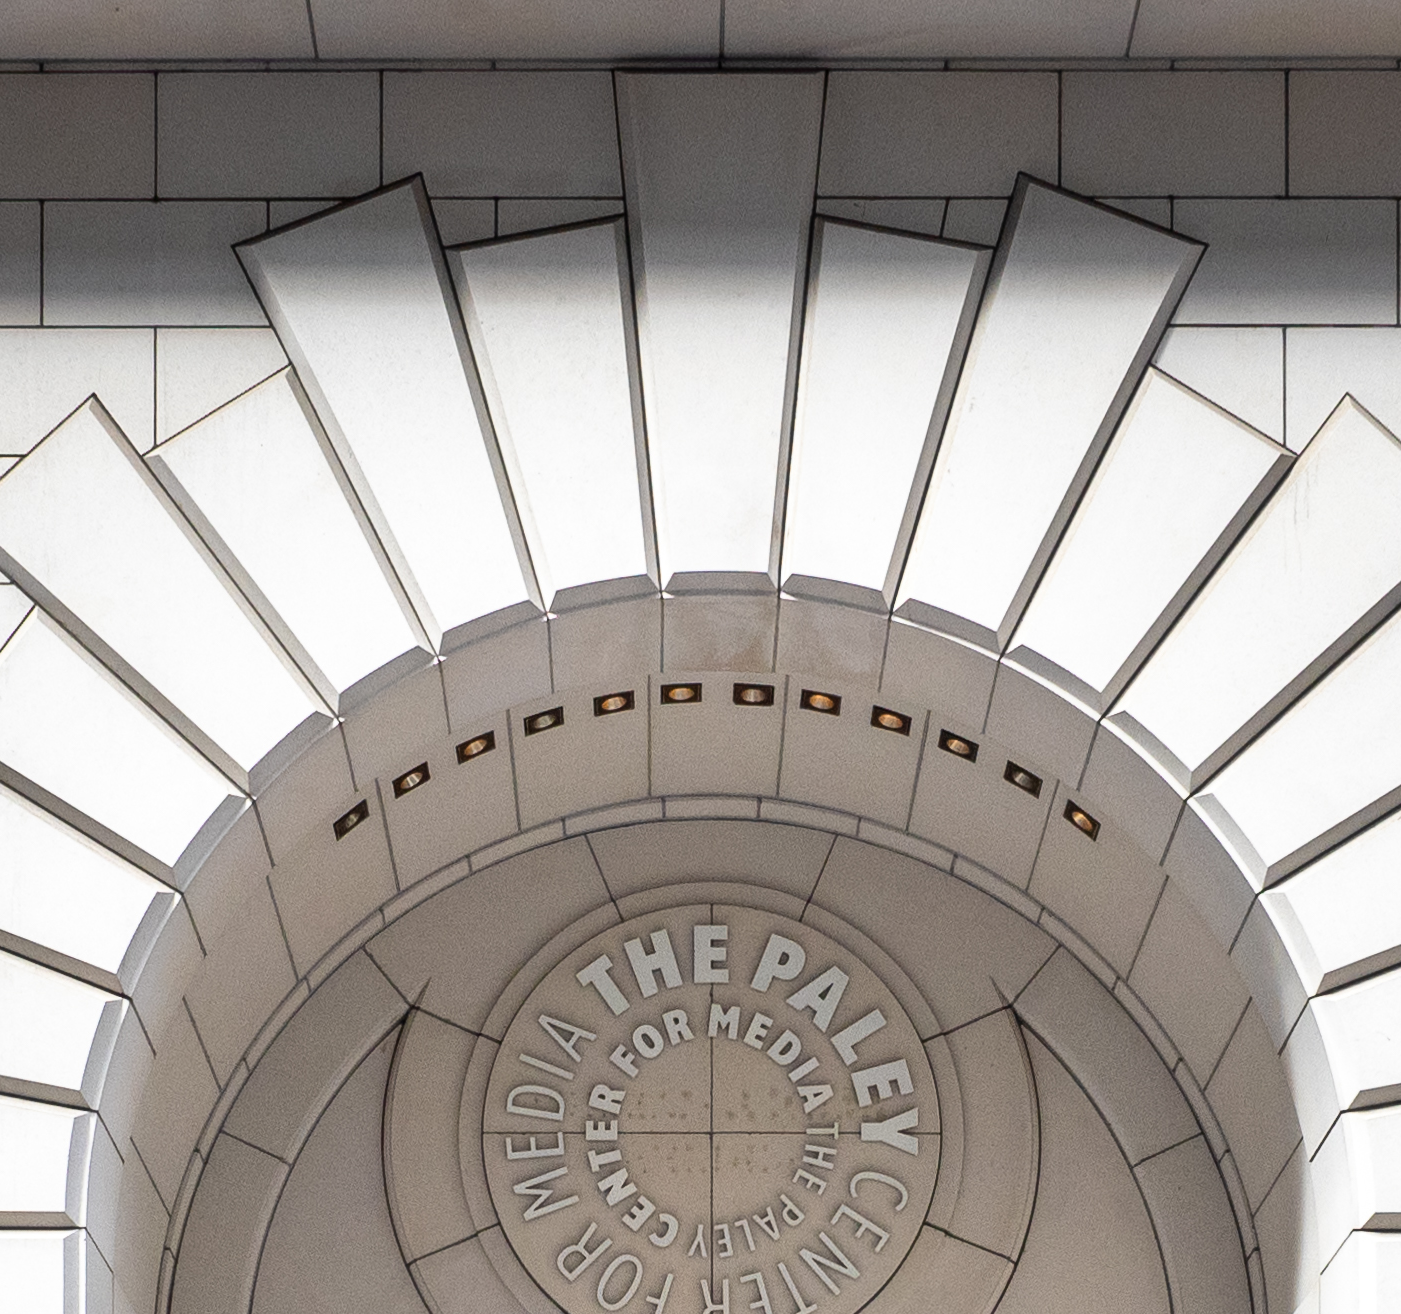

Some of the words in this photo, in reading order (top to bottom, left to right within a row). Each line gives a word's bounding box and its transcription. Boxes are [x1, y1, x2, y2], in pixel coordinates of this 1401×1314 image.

[575, 924, 730, 1017] THE
[608, 1007, 695, 1079] FOR
[707, 1002, 835, 1115] MEDIA
[750, 932, 920, 1157] PALEY
[505, 1013, 598, 1222] MEDIA
[584, 1083, 680, 1249] CENTER
[790, 1121, 840, 1196] THE
[687, 1193, 806, 1258] PALEY
